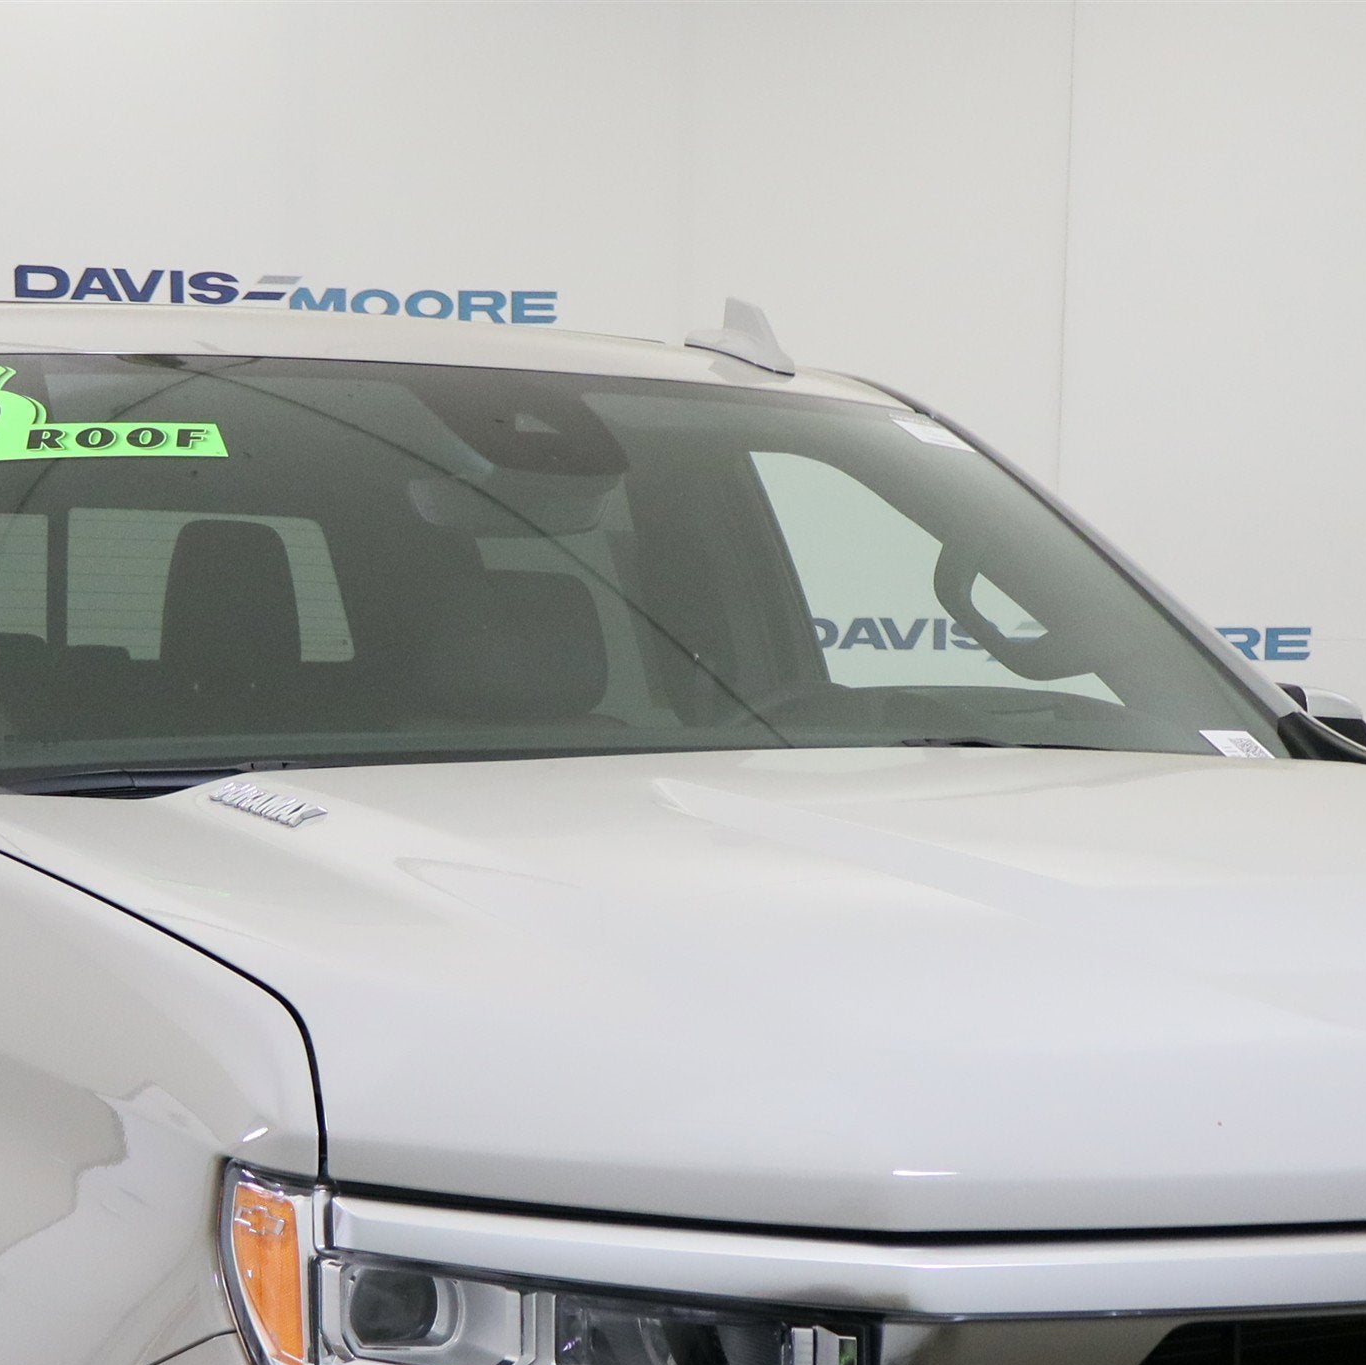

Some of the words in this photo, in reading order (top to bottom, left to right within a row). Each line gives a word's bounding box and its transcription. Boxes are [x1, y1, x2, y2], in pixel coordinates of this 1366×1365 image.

[13, 264, 241, 305] DAVIS
[288, 287, 559, 325] MOORE
[25, 427, 210, 452] ROOF
